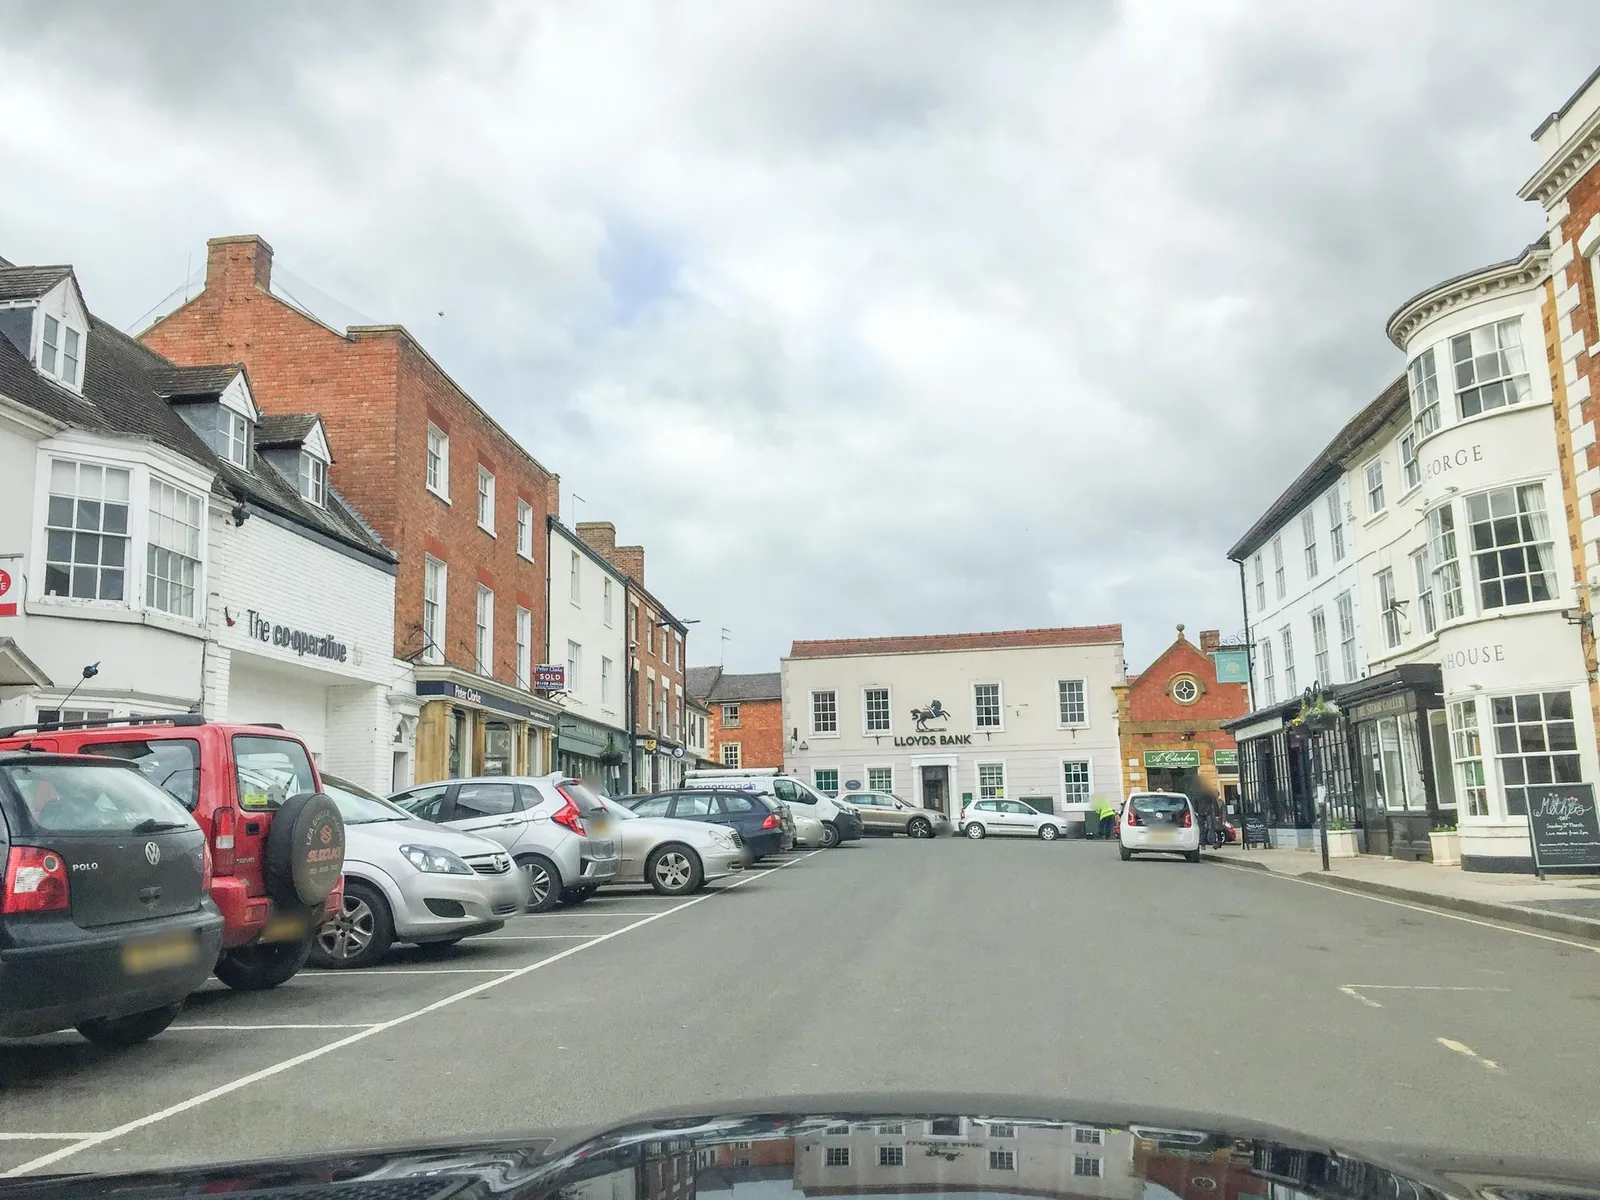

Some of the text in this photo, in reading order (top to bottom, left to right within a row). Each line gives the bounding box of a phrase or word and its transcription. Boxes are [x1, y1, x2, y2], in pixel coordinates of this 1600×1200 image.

[247, 609, 270, 642] The
[454, 684, 481, 704] Peter Clarke
[894, 734, 972, 747] LLOYDS BANK
[1163, 751, 1196, 763] Clarke
[307, 847, 342, 863] SUZUKI
[72, 862, 98, 872] POLO
